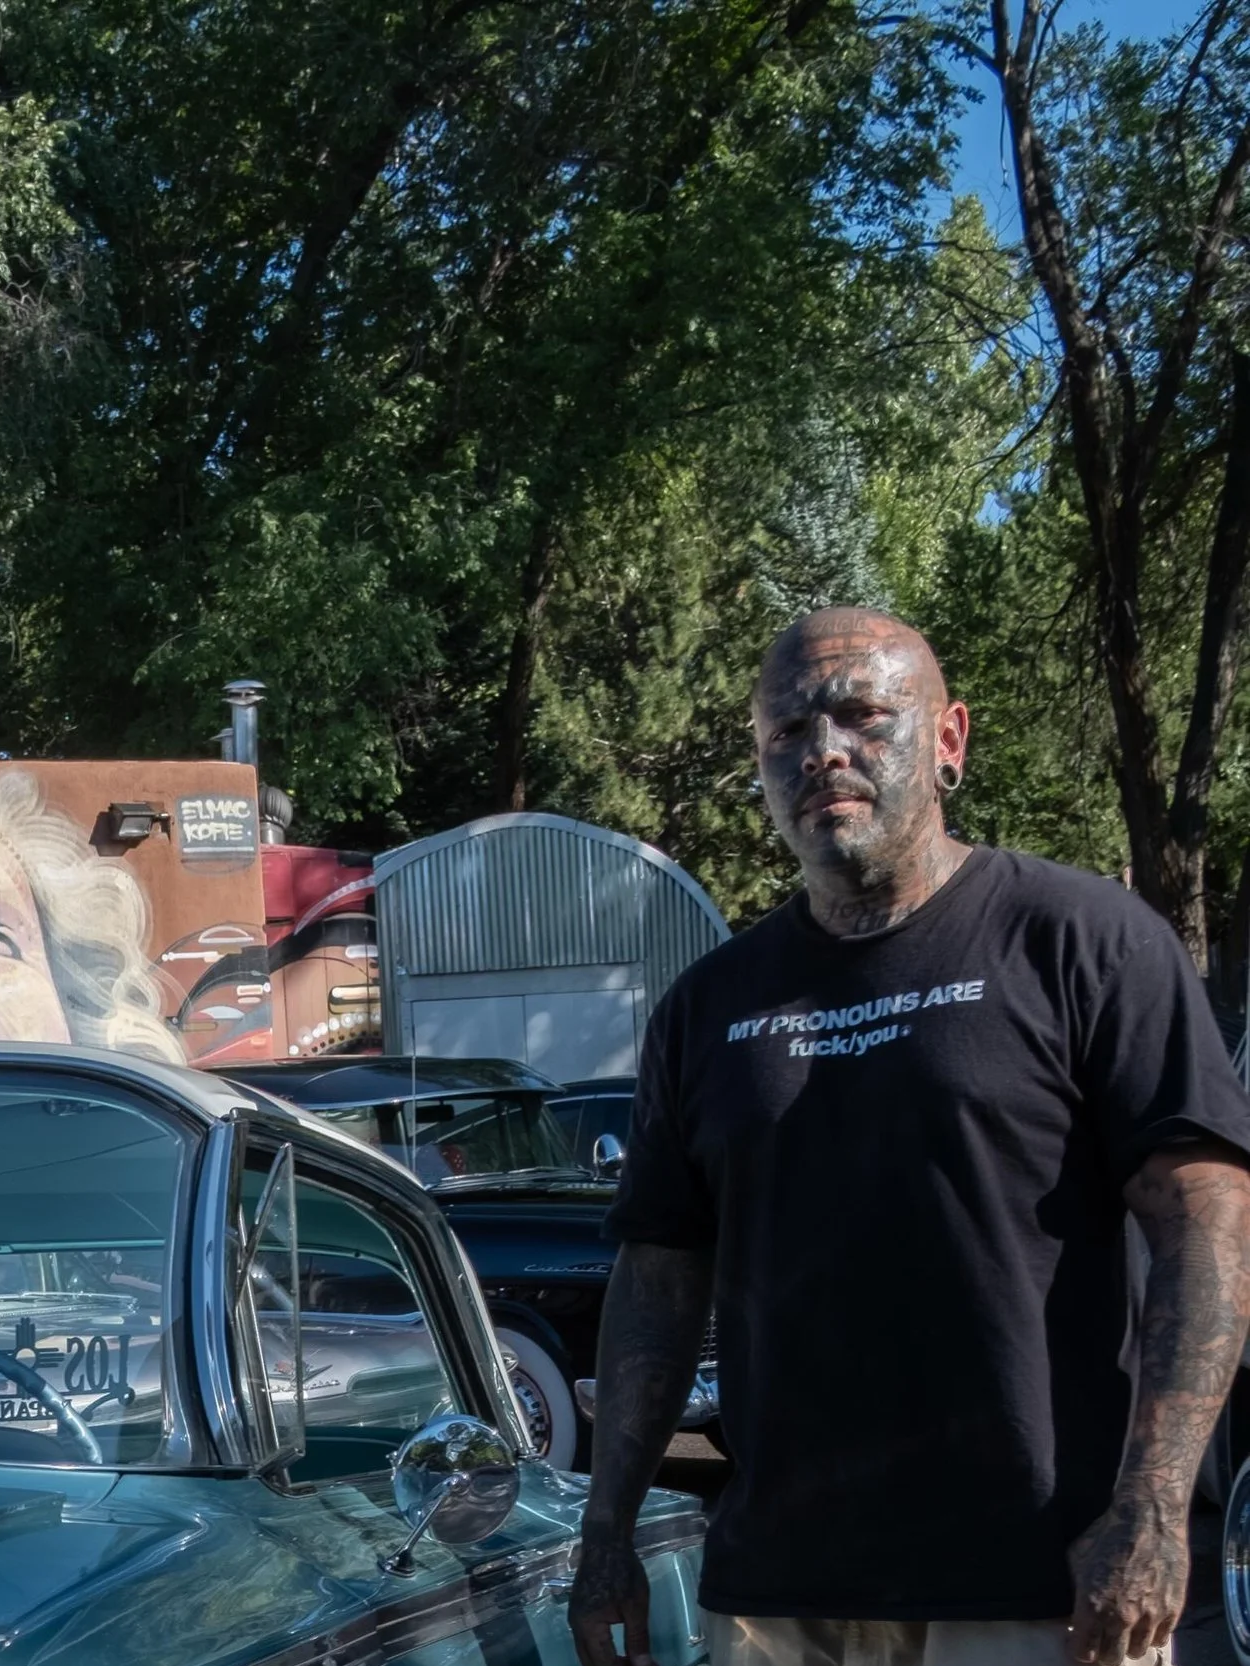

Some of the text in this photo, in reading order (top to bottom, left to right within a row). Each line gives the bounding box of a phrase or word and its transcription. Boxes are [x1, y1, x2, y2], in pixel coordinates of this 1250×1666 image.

[181, 799, 250, 820] ELMAC
[727, 980, 986, 1042] MY PRONOUNS ARE
